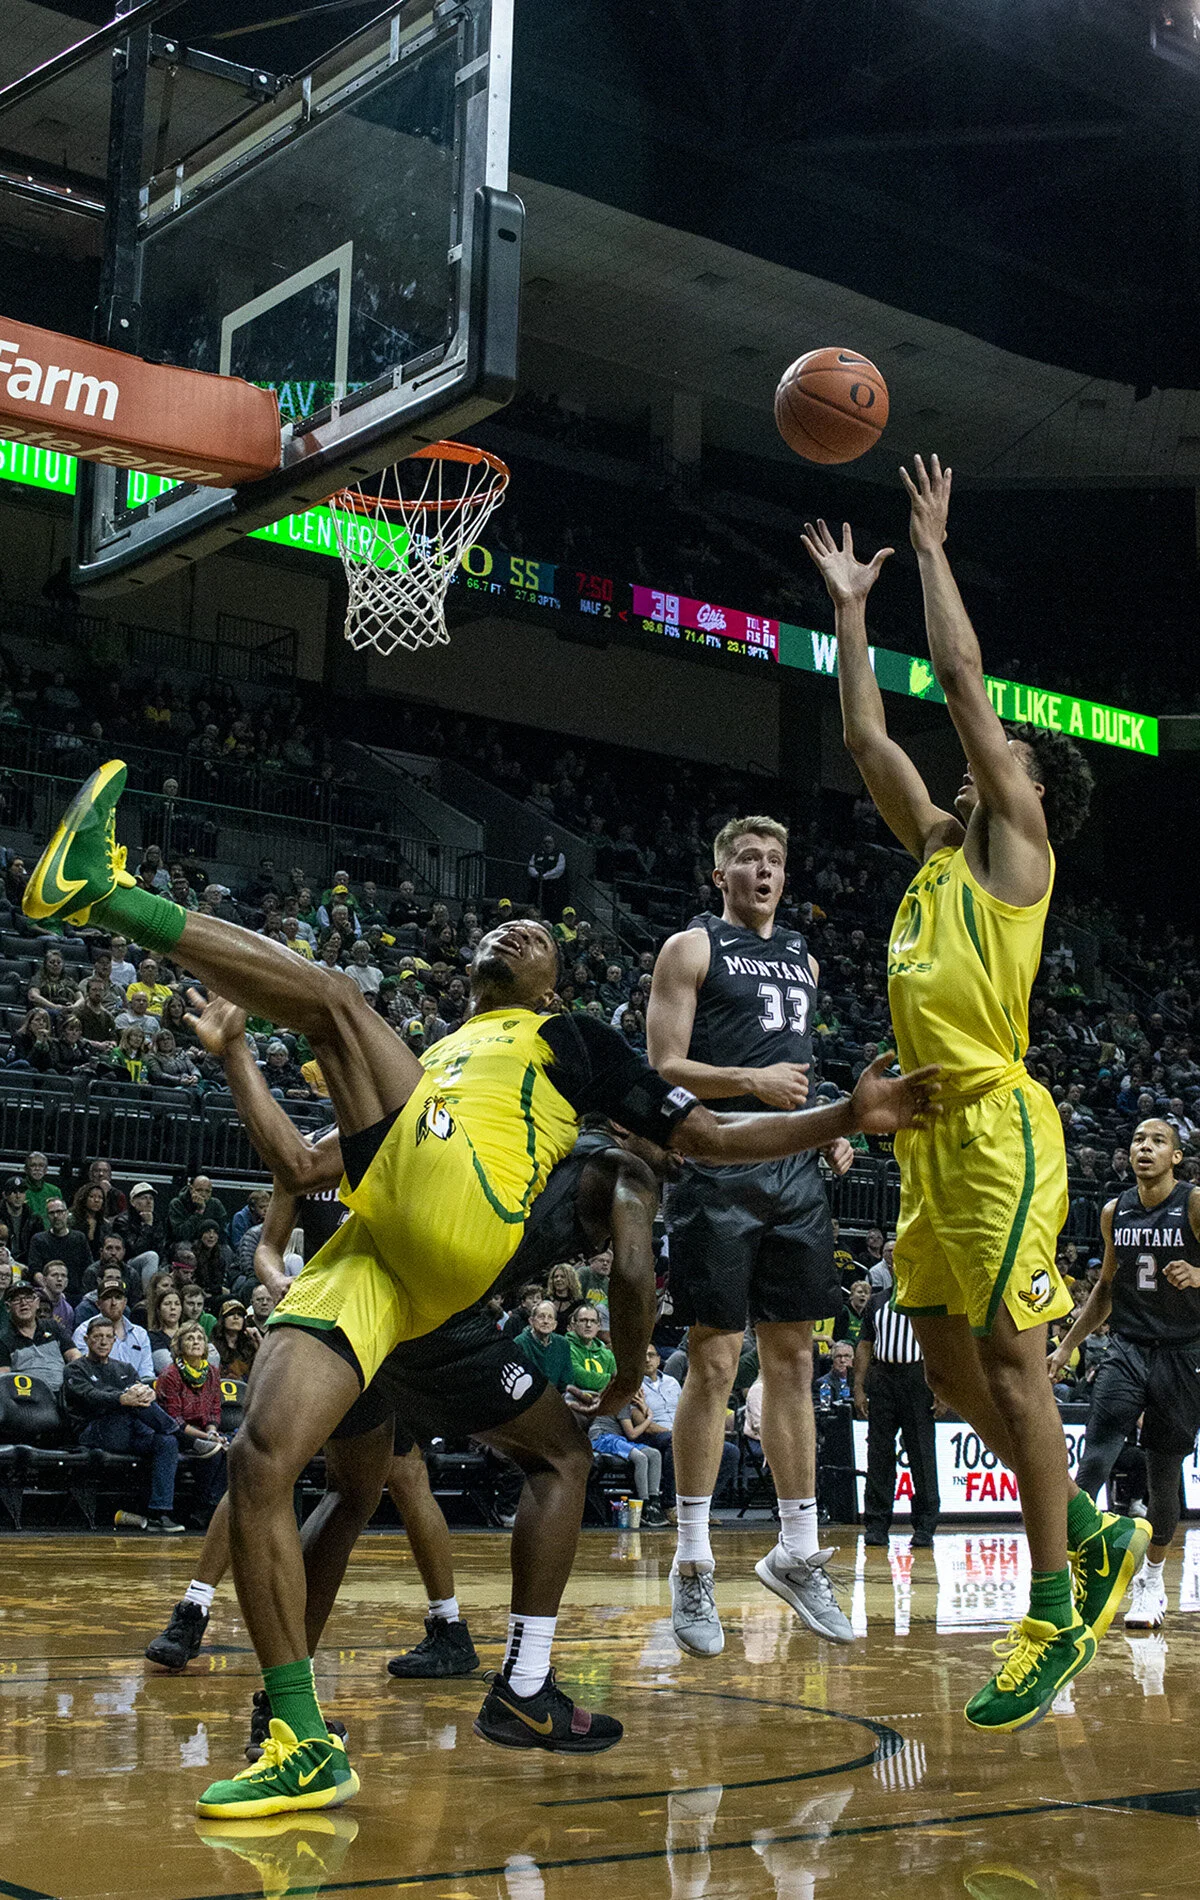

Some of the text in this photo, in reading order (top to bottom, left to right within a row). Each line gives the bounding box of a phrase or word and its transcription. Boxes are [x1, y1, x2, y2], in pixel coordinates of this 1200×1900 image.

[510, 556, 540, 591] 55
[466, 577, 489, 592] 66.7
[515, 589, 537, 603] 27.8
[580, 598, 612, 618] HALF 2
[651, 590, 680, 626] 39
[762, 620, 770, 633] 2
[684, 629, 705, 644] 71.4
[727, 640, 746, 654] 23.1
[1014, 686, 1062, 730] LIKE
[1069, 701, 1084, 735] A
[1092, 706, 1145, 751] DUCK
[757, 983, 810, 1036] 33
[1114, 1228, 1185, 1247] MONTANA
[1136, 1253, 1158, 1292] 2
[966, 1472, 1018, 1501] FAN
